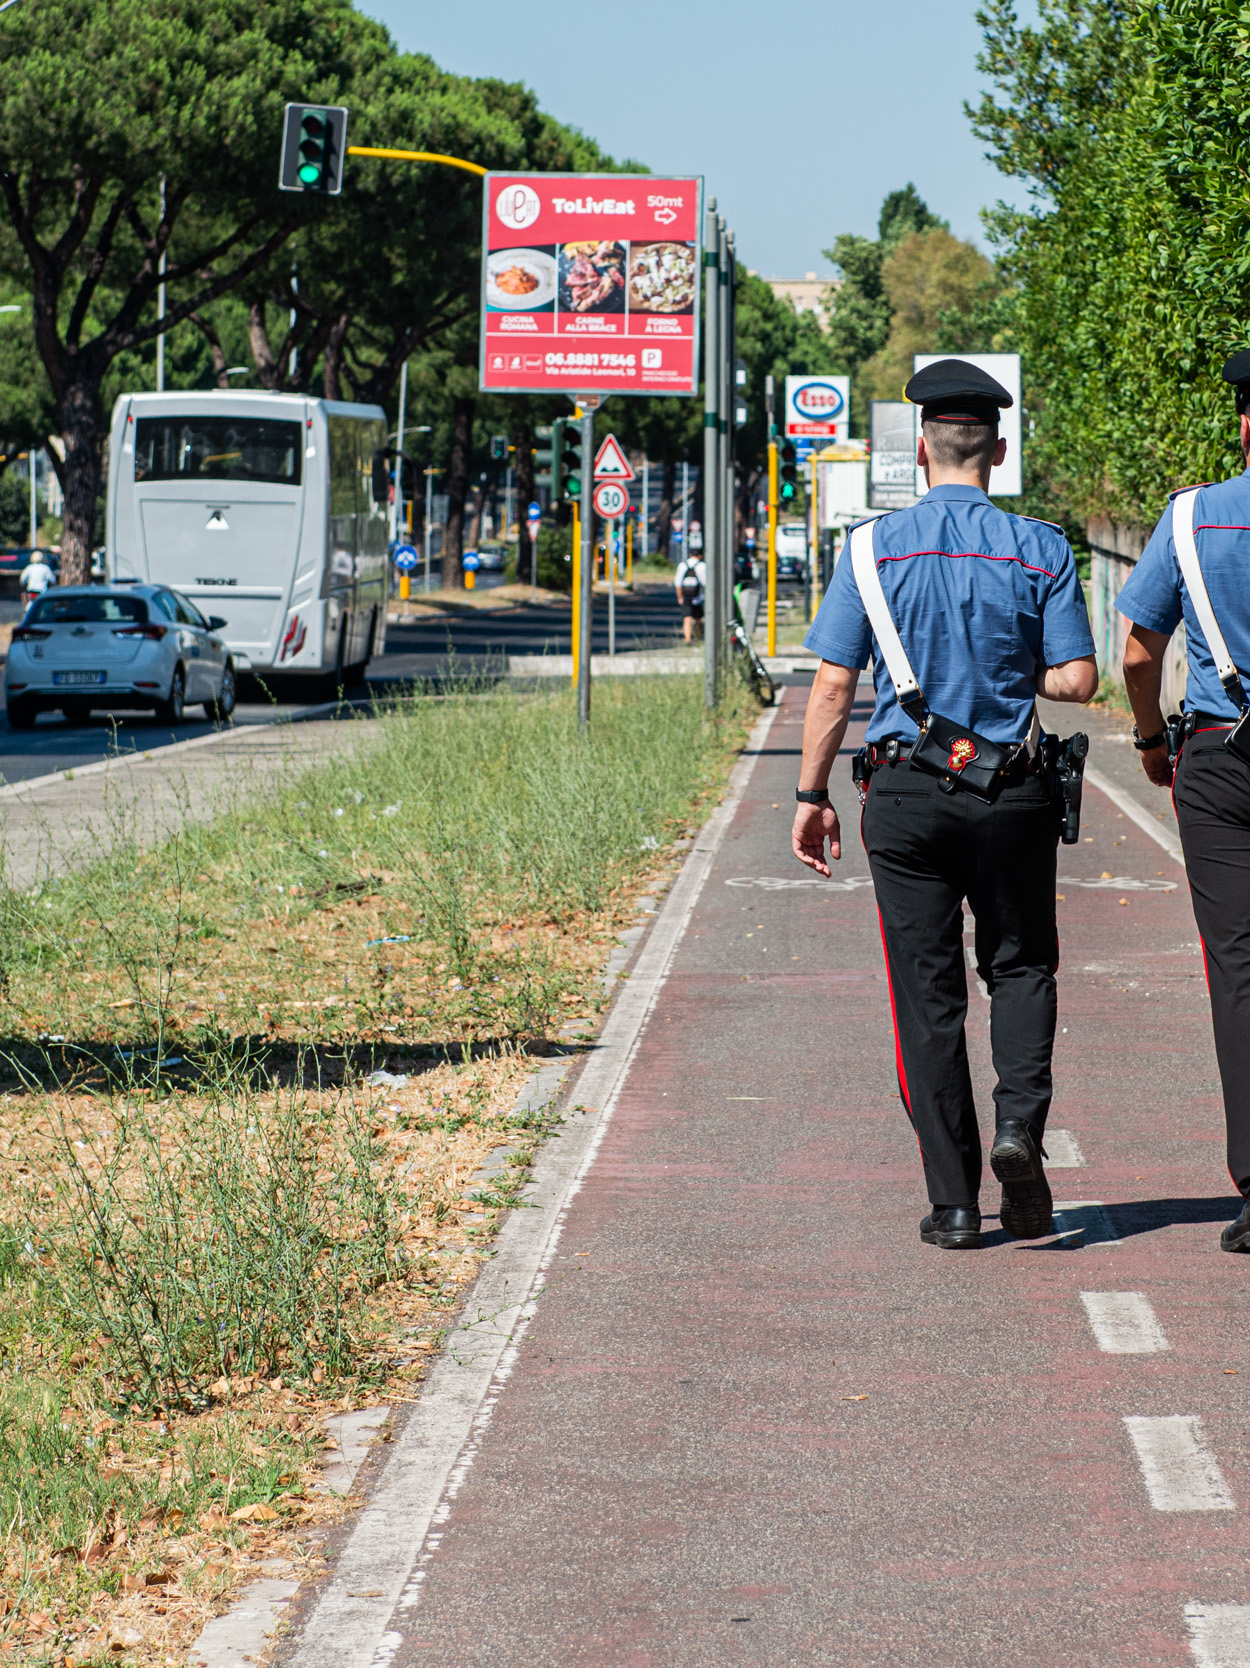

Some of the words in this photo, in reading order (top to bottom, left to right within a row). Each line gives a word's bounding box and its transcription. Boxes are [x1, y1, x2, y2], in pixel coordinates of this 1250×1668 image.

[551, 196, 636, 215] ToLivEat
[647, 195, 683, 208] 50mt
[501, 315, 535, 323] CUCINA
[575, 316, 605, 324] CARNE
[647, 317, 678, 326] FORNO
[500, 322, 539, 331] ROMANA
[565, 323, 588, 332] ALLA
[588, 324, 617, 333] BRACE
[645, 325, 652, 333] A
[653, 325, 683, 334] LEGNA
[545, 353, 599, 366] 06.8881
[600, 354, 637, 367] 7546
[800, 389, 836, 407] Esso
[602, 491, 621, 507] 30
[195, 577, 238, 586] TEKNE
